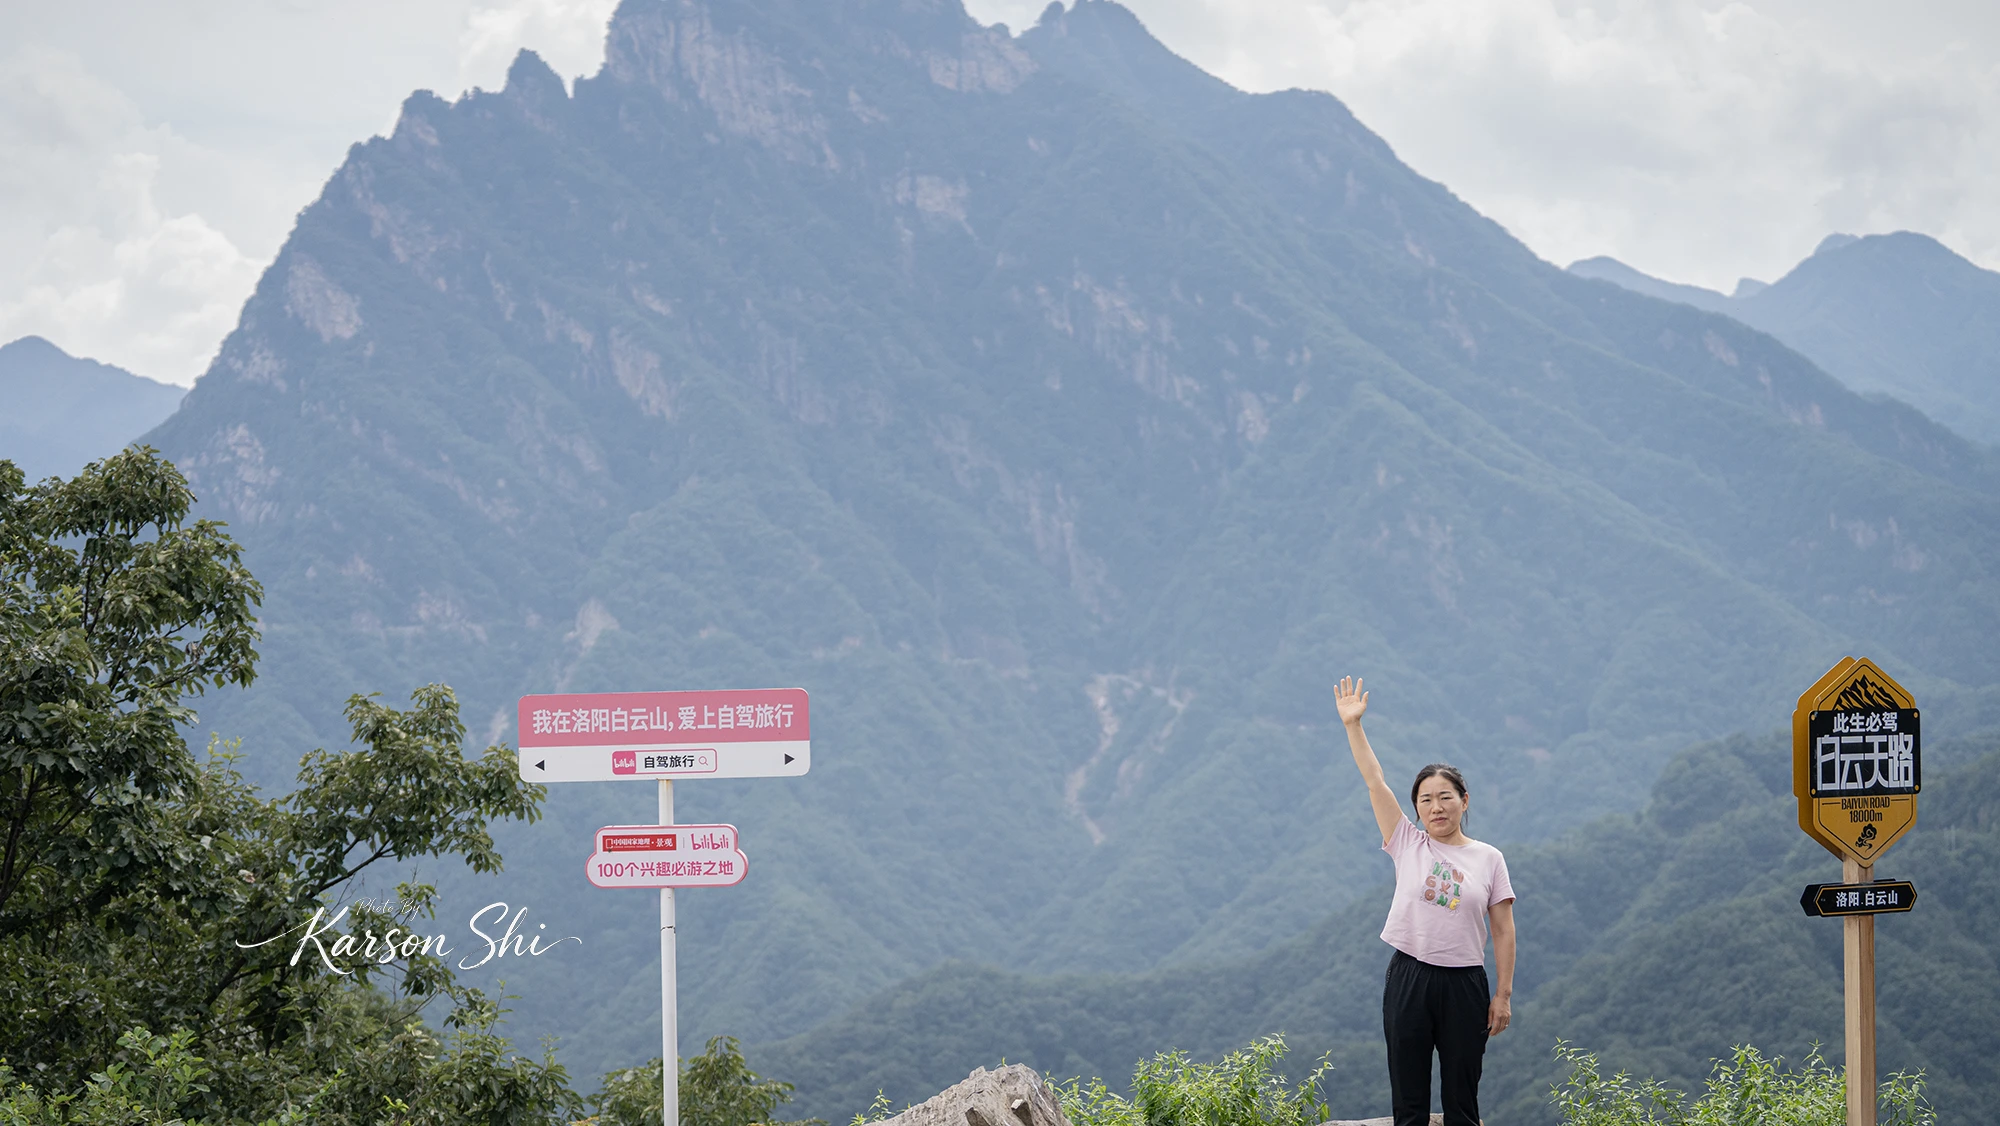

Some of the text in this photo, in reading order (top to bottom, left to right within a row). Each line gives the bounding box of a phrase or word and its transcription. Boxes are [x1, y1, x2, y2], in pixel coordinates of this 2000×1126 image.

[1832, 711, 1898, 734] 此生必驾
[644, 755, 695, 769] 自驾旅行
[1816, 732, 1914, 791] 白云天路
[1841, 796, 1890, 810] BAIYUN ROAD
[1849, 809, 1883, 823] 18000m
[690, 833, 729, 851] bilibili
[597, 860, 734, 878] 100个兴趣必游之地
